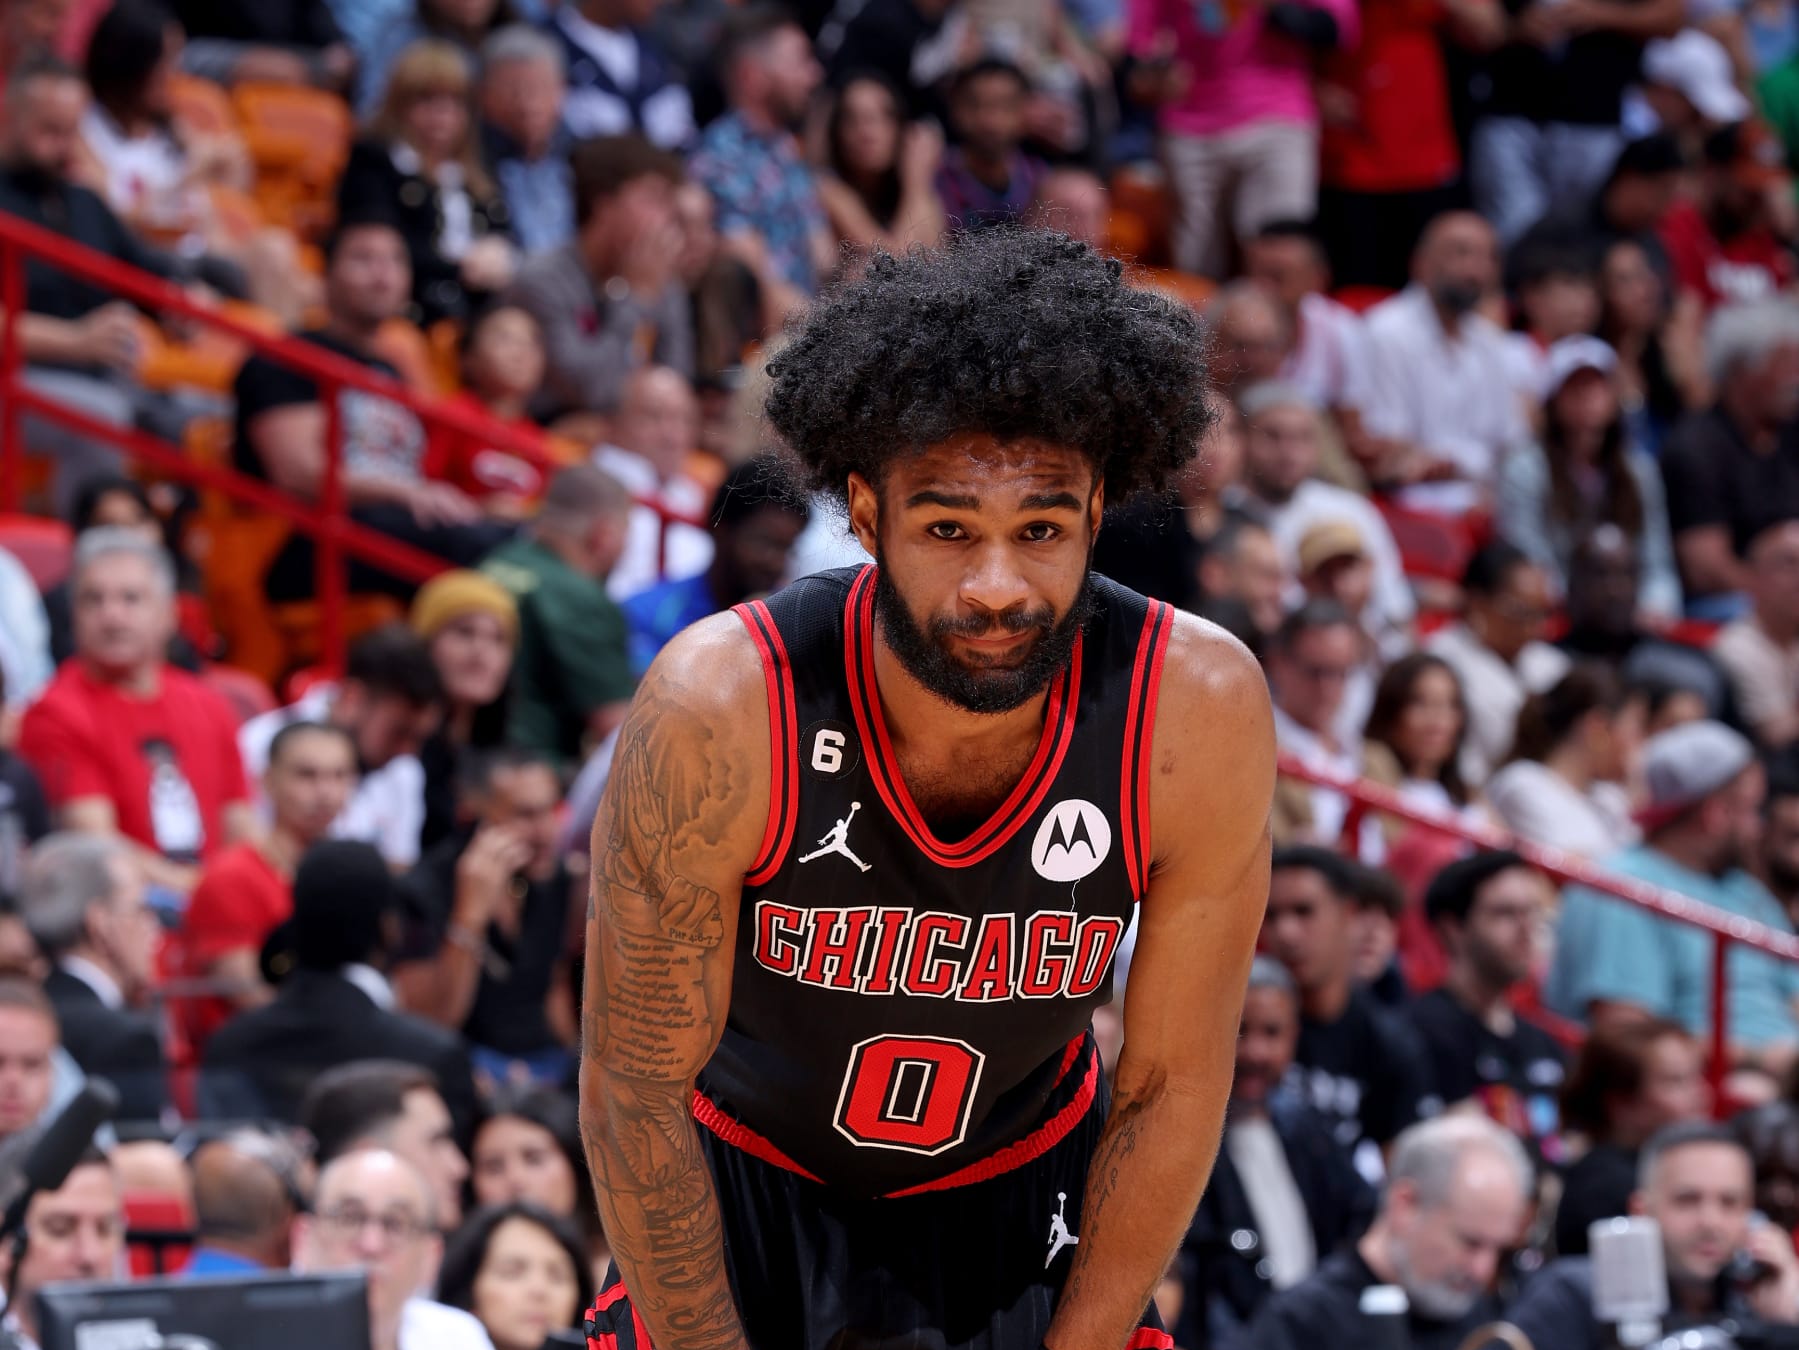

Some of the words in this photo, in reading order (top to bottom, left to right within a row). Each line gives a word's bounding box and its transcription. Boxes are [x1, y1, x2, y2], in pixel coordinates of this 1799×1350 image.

[812, 729, 846, 773] 6
[753, 900, 1124, 1003] CHICAGO
[832, 1033, 986, 1156] 0
